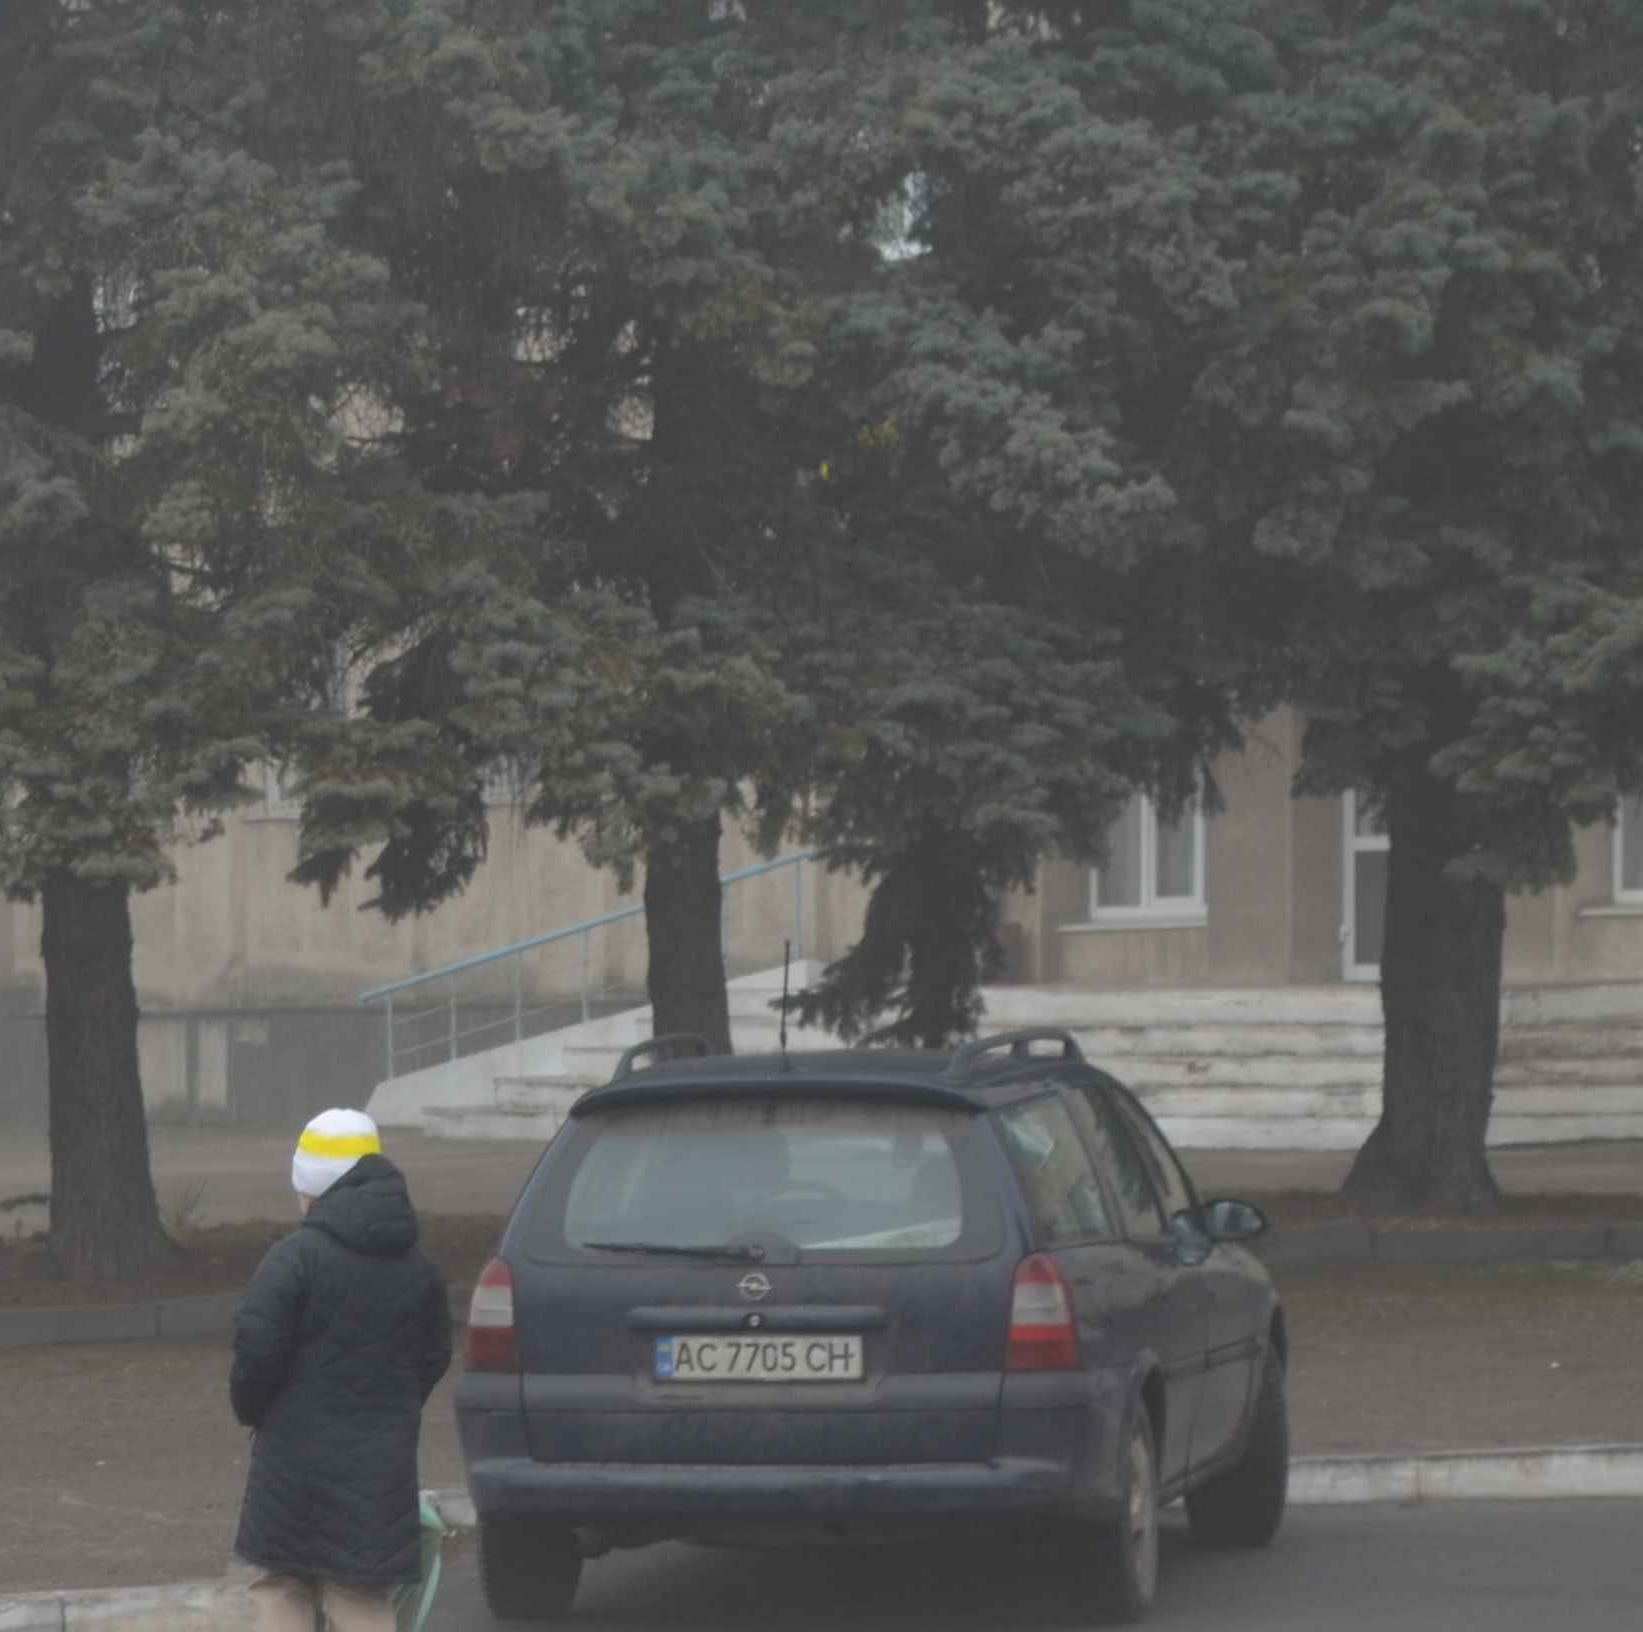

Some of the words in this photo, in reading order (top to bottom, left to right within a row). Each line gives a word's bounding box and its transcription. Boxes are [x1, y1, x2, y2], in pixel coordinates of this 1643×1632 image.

[675, 1342, 717, 1372] AC
[726, 1342, 797, 1372] 7705
[805, 1342, 851, 1372] CH
